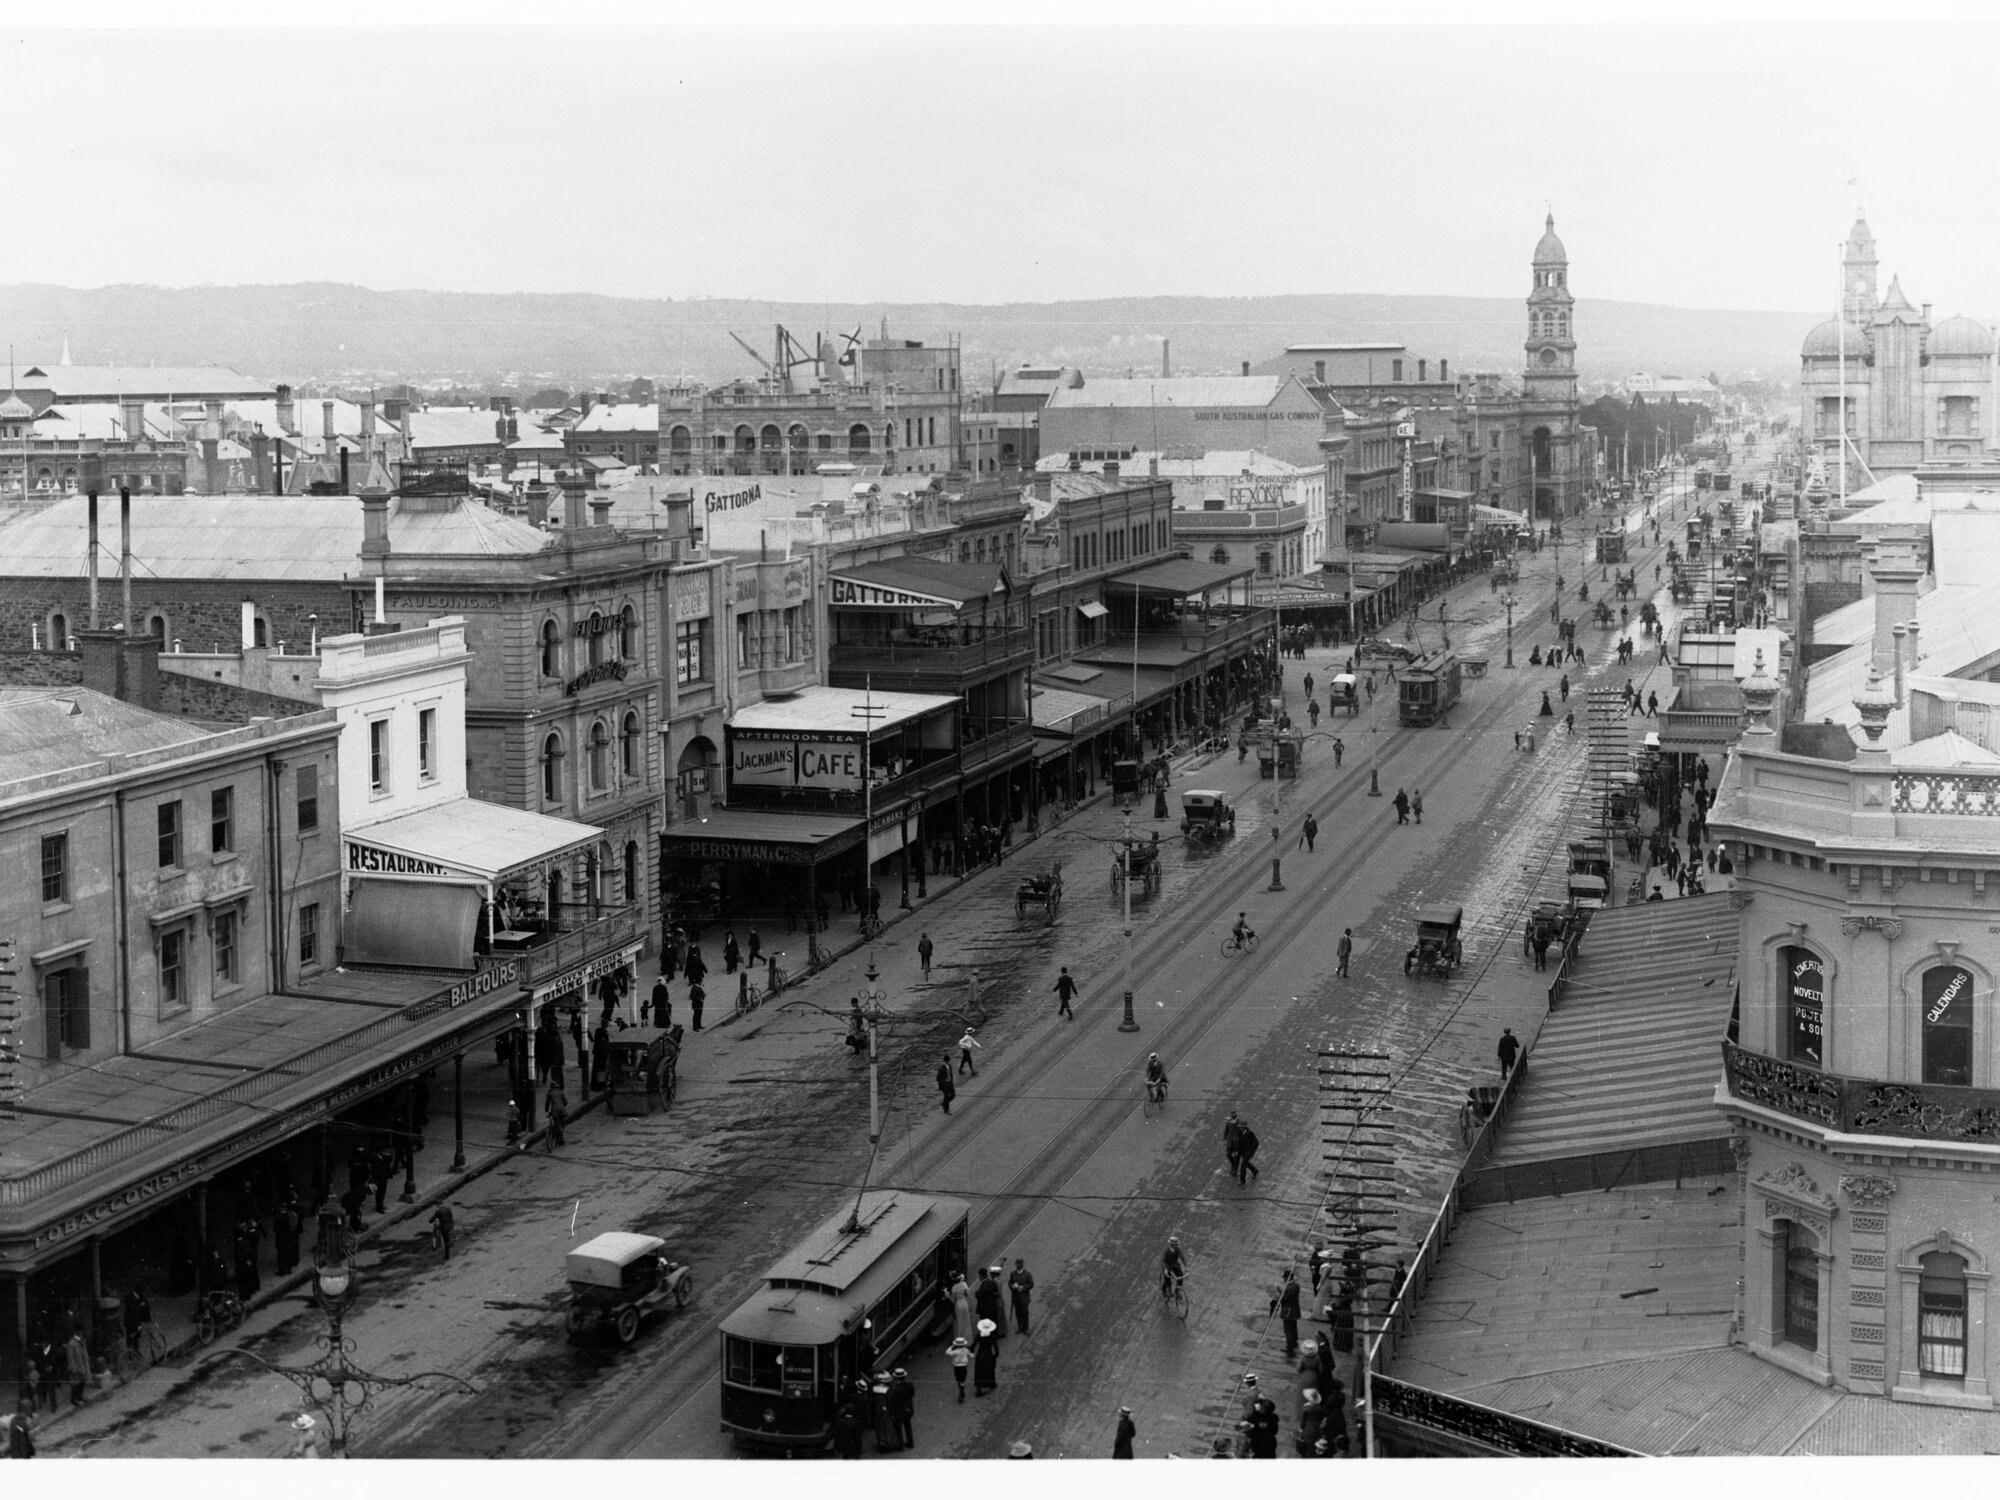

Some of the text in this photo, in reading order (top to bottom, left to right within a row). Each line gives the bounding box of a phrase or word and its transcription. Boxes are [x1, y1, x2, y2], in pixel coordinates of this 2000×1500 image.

[1195, 411, 1320, 420] SOUTH AUSTRALIAN GAS COMPANY
[704, 484, 761, 513] GATTORNA
[1230, 487, 1284, 506] REXONA
[736, 732, 819, 741] AFTERNOON
[735, 747, 793, 771] JACKMAN'S
[349, 843, 447, 875] RESTAURANT.
[690, 842, 768, 860] PERRYMAN
[501, 852, 570, 879] AFTERNOON
[542, 959, 627, 1002] DINING ROOMS.
[555, 952, 623, 988] COVENT GARDEN
[451, 962, 517, 1008] BALFOURS
[1927, 972, 1968, 1023] CALENDARS
[1800, 1022, 1806, 1032] &
[329, 1084, 360, 1106] MERCER
[378, 1052, 424, 1084] LEAVER
[431, 1037, 459, 1059] HATTER
